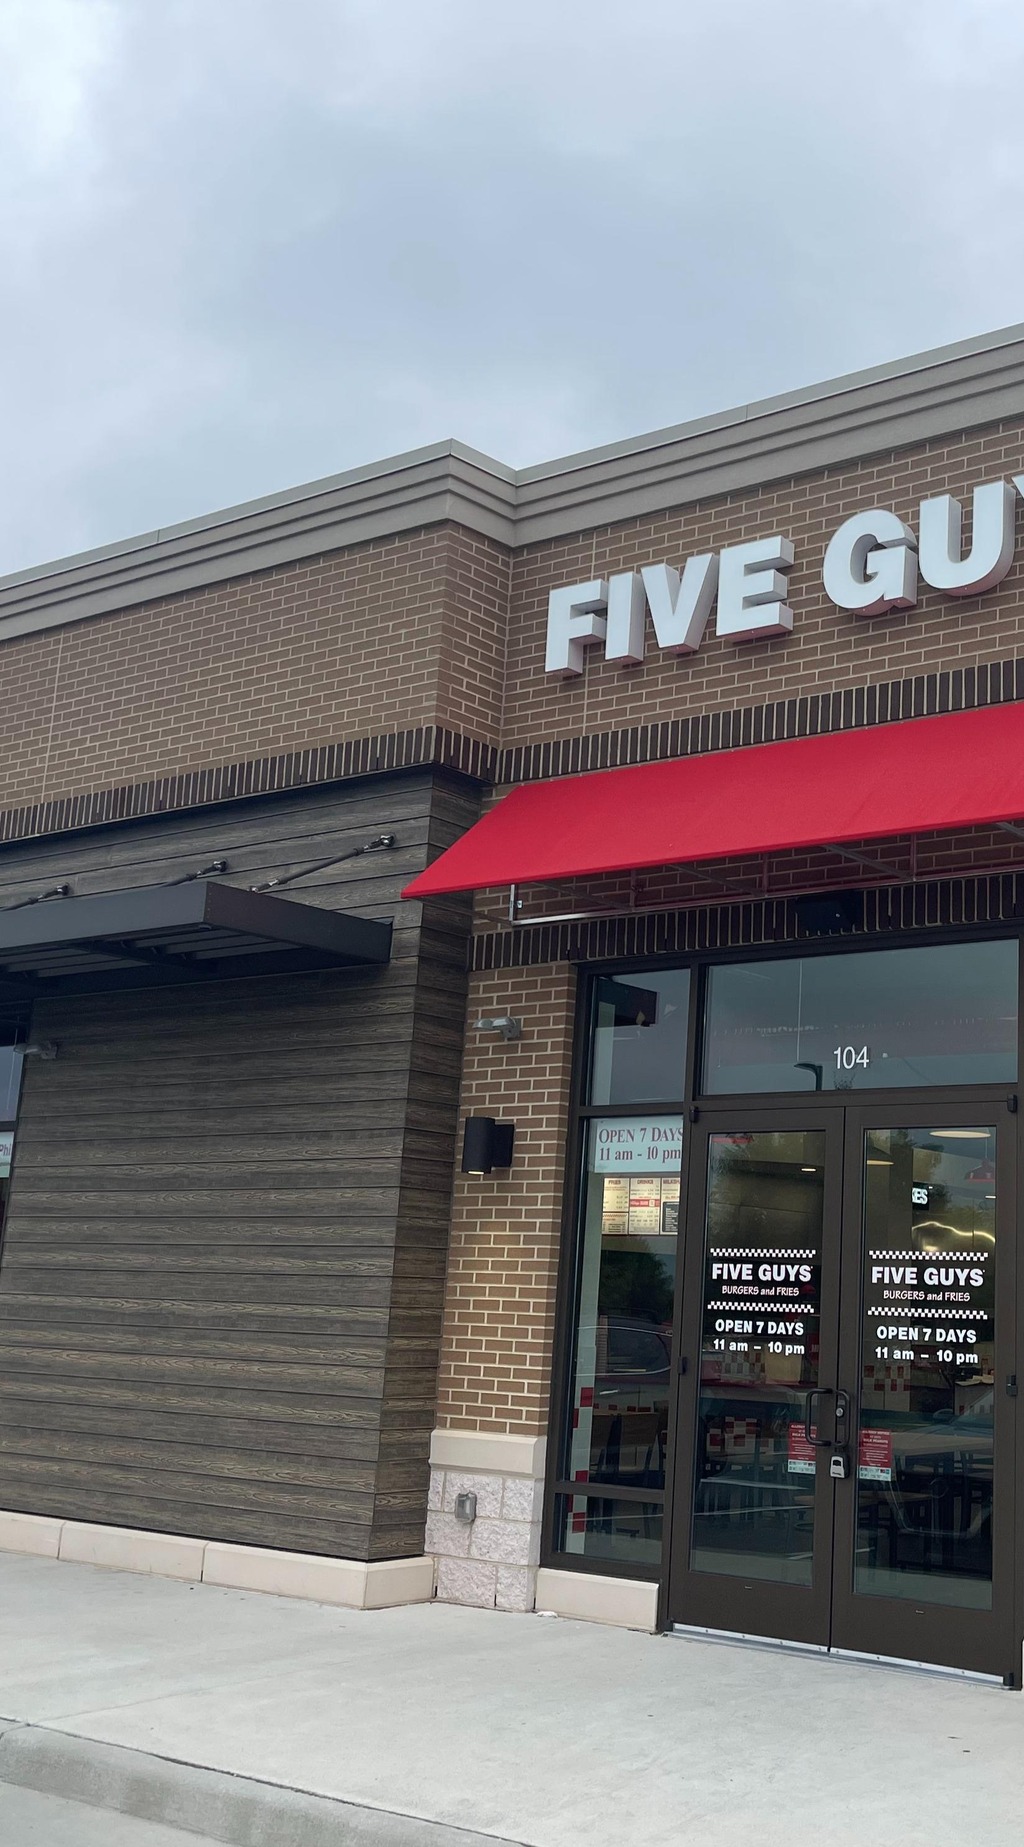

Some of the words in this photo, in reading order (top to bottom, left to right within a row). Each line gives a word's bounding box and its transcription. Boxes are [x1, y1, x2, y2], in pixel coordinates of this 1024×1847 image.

[545, 536, 794, 676] FIVE
[833, 1045, 870, 1070] 104
[599, 1128, 635, 1144] OPEN
[640, 1127, 647, 1142] 7
[600, 1147, 610, 1161] 11
[614, 1150, 633, 1161] am
[647, 1145, 659, 1160] 10
[662, 1149, 681, 1163] pm
[712, 1263, 753, 1280] FIVE
[758, 1264, 812, 1282] GUYS
[871, 1266, 918, 1285] FIVE
[923, 1267, 984, 1287] GUYS
[721, 1285, 759, 1295] BURGERS
[760, 1287, 775, 1296] and
[776, 1287, 800, 1297] FRIES
[883, 1290, 925, 1301] BURGERS
[926, 1292, 943, 1301] and
[944, 1292, 971, 1302] FRIES
[715, 1319, 753, 1334] OPEN
[755, 1322, 765, 1334] 7
[767, 1322, 804, 1336] DAYS
[876, 1326, 918, 1341] OPEN
[922, 1328, 932, 1341] 7
[935, 1329, 977, 1344] DAYS
[713, 1339, 726, 1351] 11
[729, 1342, 748, 1352] am
[768, 1341, 783, 1354] 10
[785, 1345, 805, 1356] pm
[875, 1346, 888, 1359] 11
[893, 1349, 915, 1360] am
[936, 1350, 953, 1362] 10
[956, 1353, 979, 1365] pm
